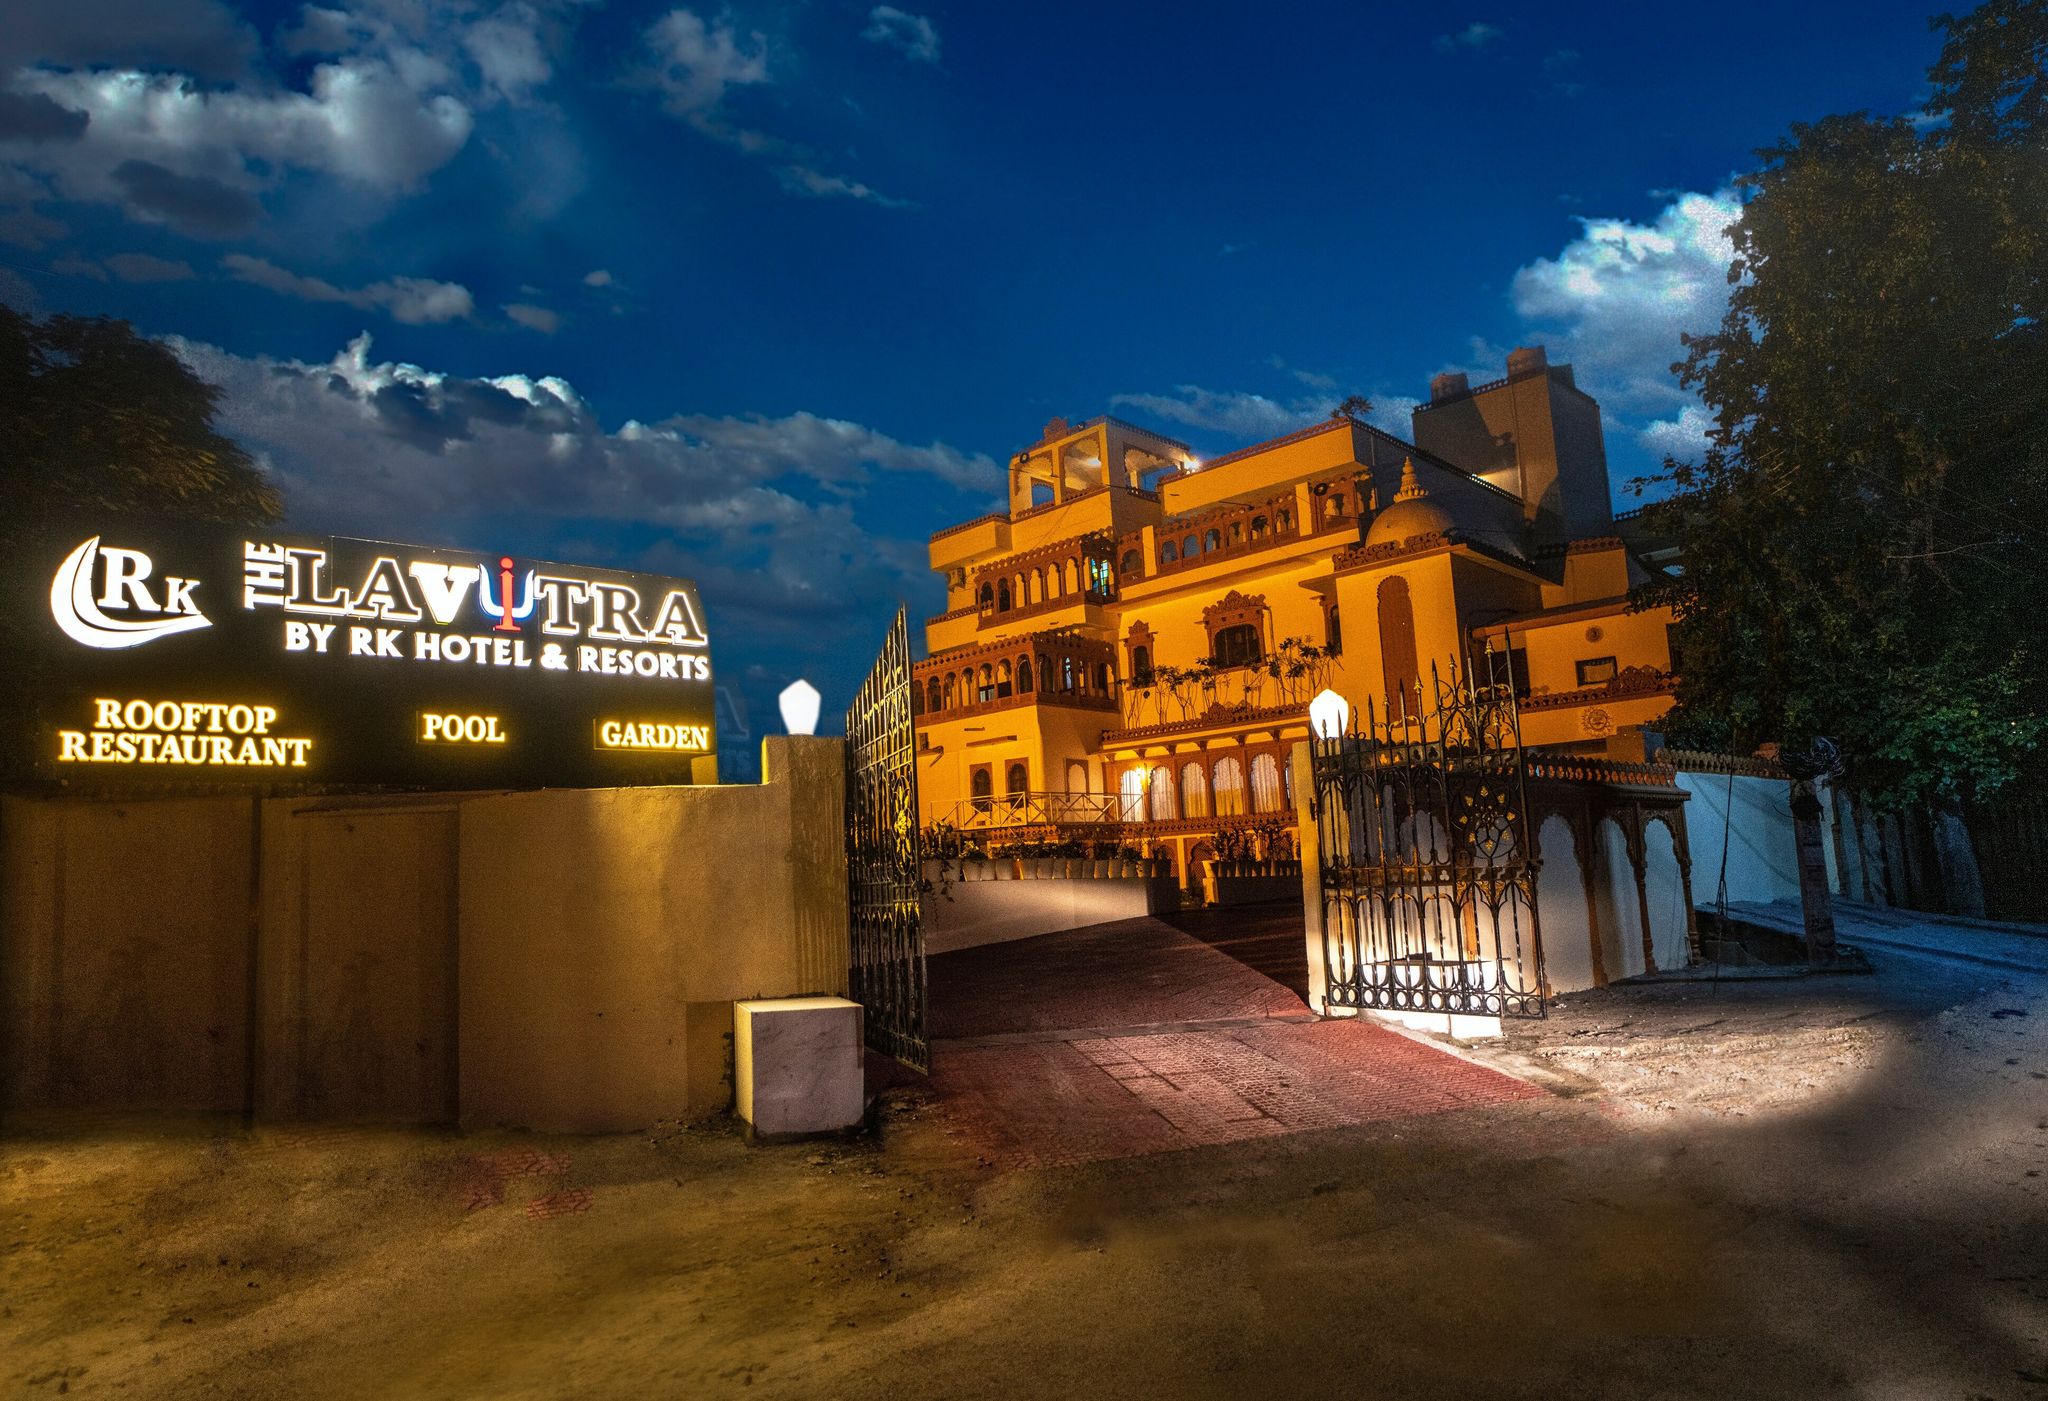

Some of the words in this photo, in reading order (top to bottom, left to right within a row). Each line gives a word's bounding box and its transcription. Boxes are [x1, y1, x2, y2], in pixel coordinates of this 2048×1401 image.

[98, 546, 202, 616] RK
[244, 541, 285, 610] THE
[285, 621, 337, 653] BY
[351, 626, 403, 657] RK
[414, 632, 532, 668] HOTEL
[540, 645, 569, 671] &
[577, 646, 709, 681] RESORTS
[94, 698, 277, 735] ROOFTOP
[422, 713, 506, 743] POOL
[601, 720, 709, 750] GARDEN
[58, 730, 312, 767] RESTAURANT
